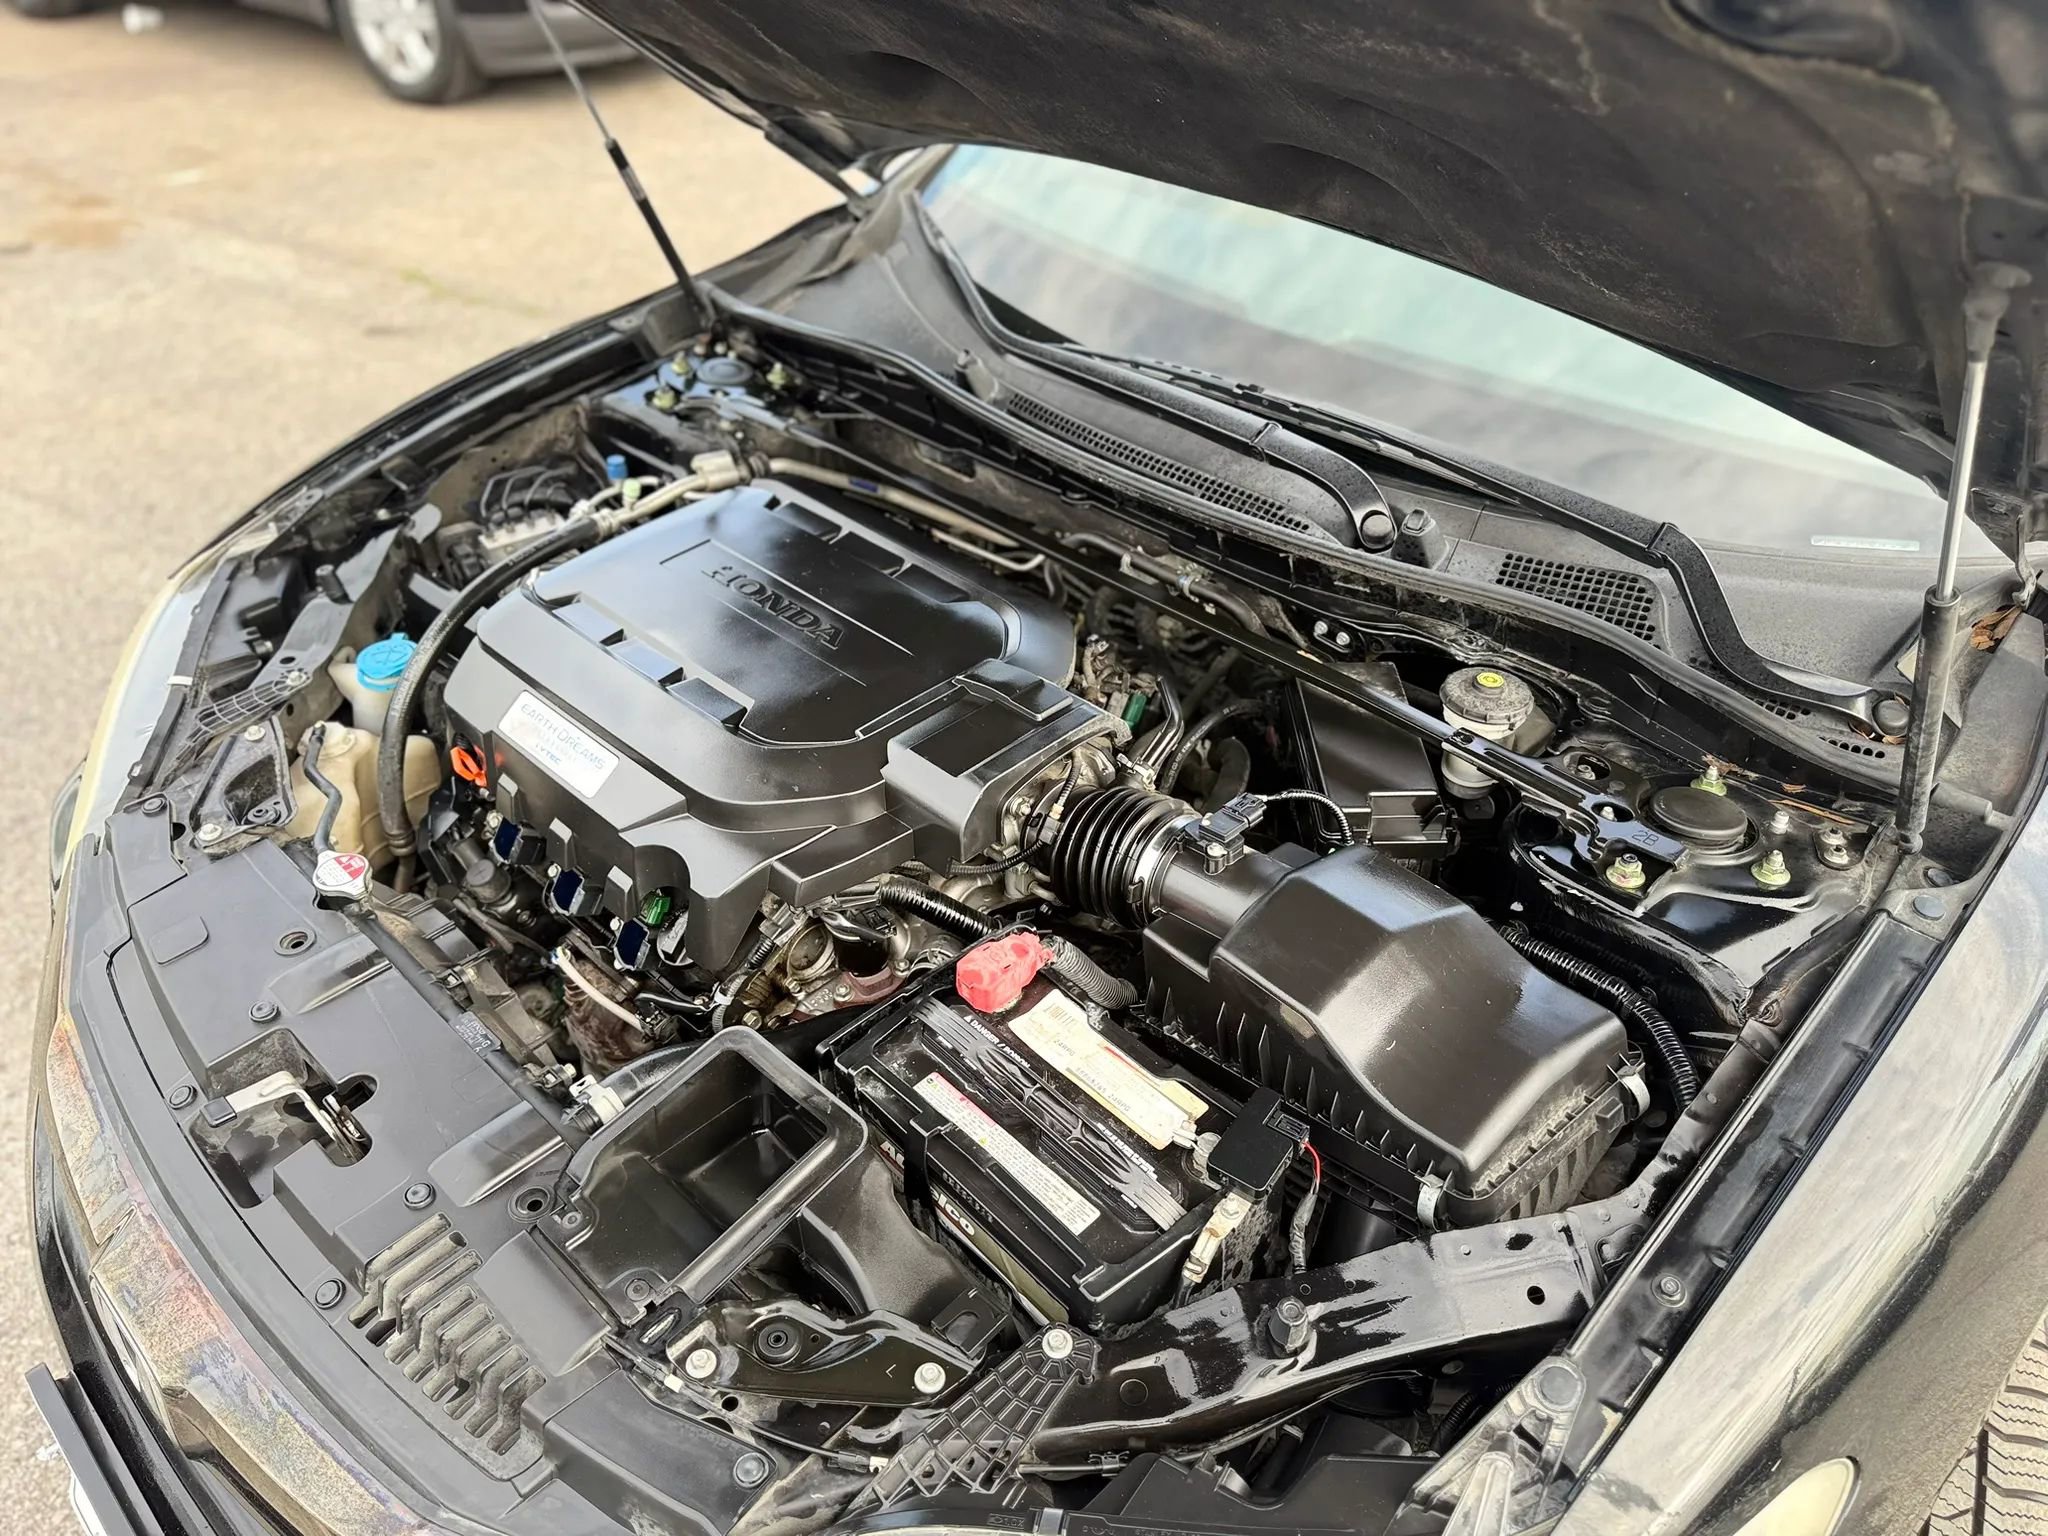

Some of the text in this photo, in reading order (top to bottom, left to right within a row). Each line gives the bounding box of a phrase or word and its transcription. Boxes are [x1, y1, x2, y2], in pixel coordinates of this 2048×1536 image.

[702, 565, 844, 650] HONDA
[520, 703, 559, 734] EARTH
[970, 1019, 1000, 1045] DANGER
